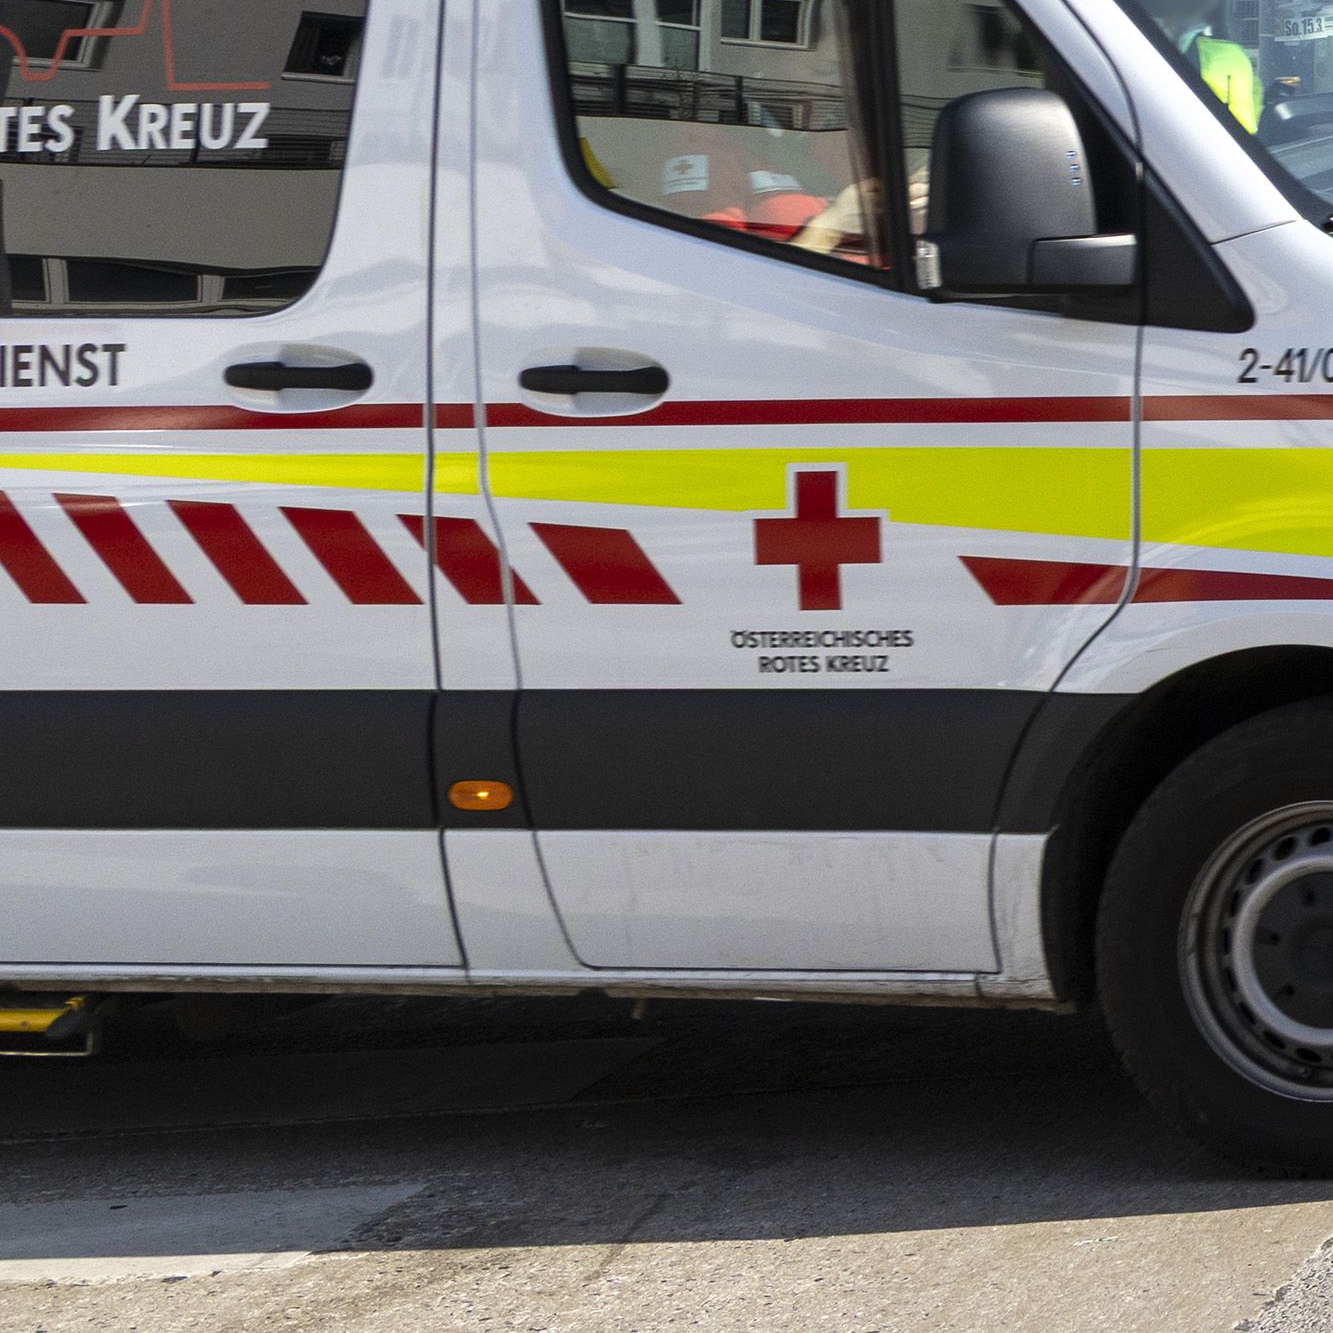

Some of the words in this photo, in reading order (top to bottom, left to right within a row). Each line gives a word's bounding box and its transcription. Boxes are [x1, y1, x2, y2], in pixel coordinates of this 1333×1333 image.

[730, 630, 915, 649] ÖSTERREICHISCHES
[758, 655, 821, 673] ROTES
[825, 655, 890, 673] KREUZ
